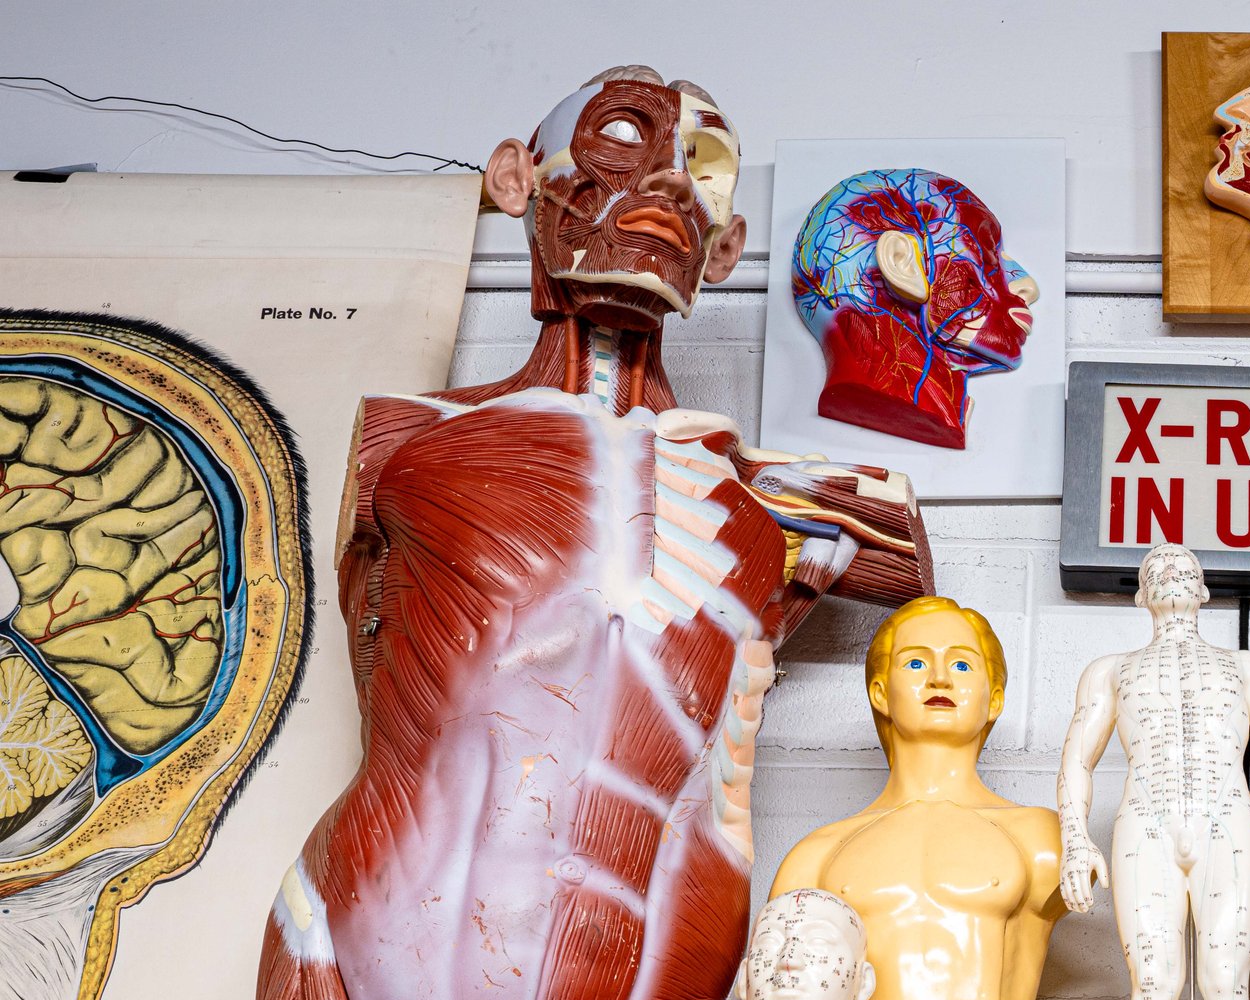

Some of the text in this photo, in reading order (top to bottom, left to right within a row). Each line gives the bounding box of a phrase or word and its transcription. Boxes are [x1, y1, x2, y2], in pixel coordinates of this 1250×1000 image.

[260, 307, 357, 320] Plate No. 7
[1109, 476, 1185, 545] IN
